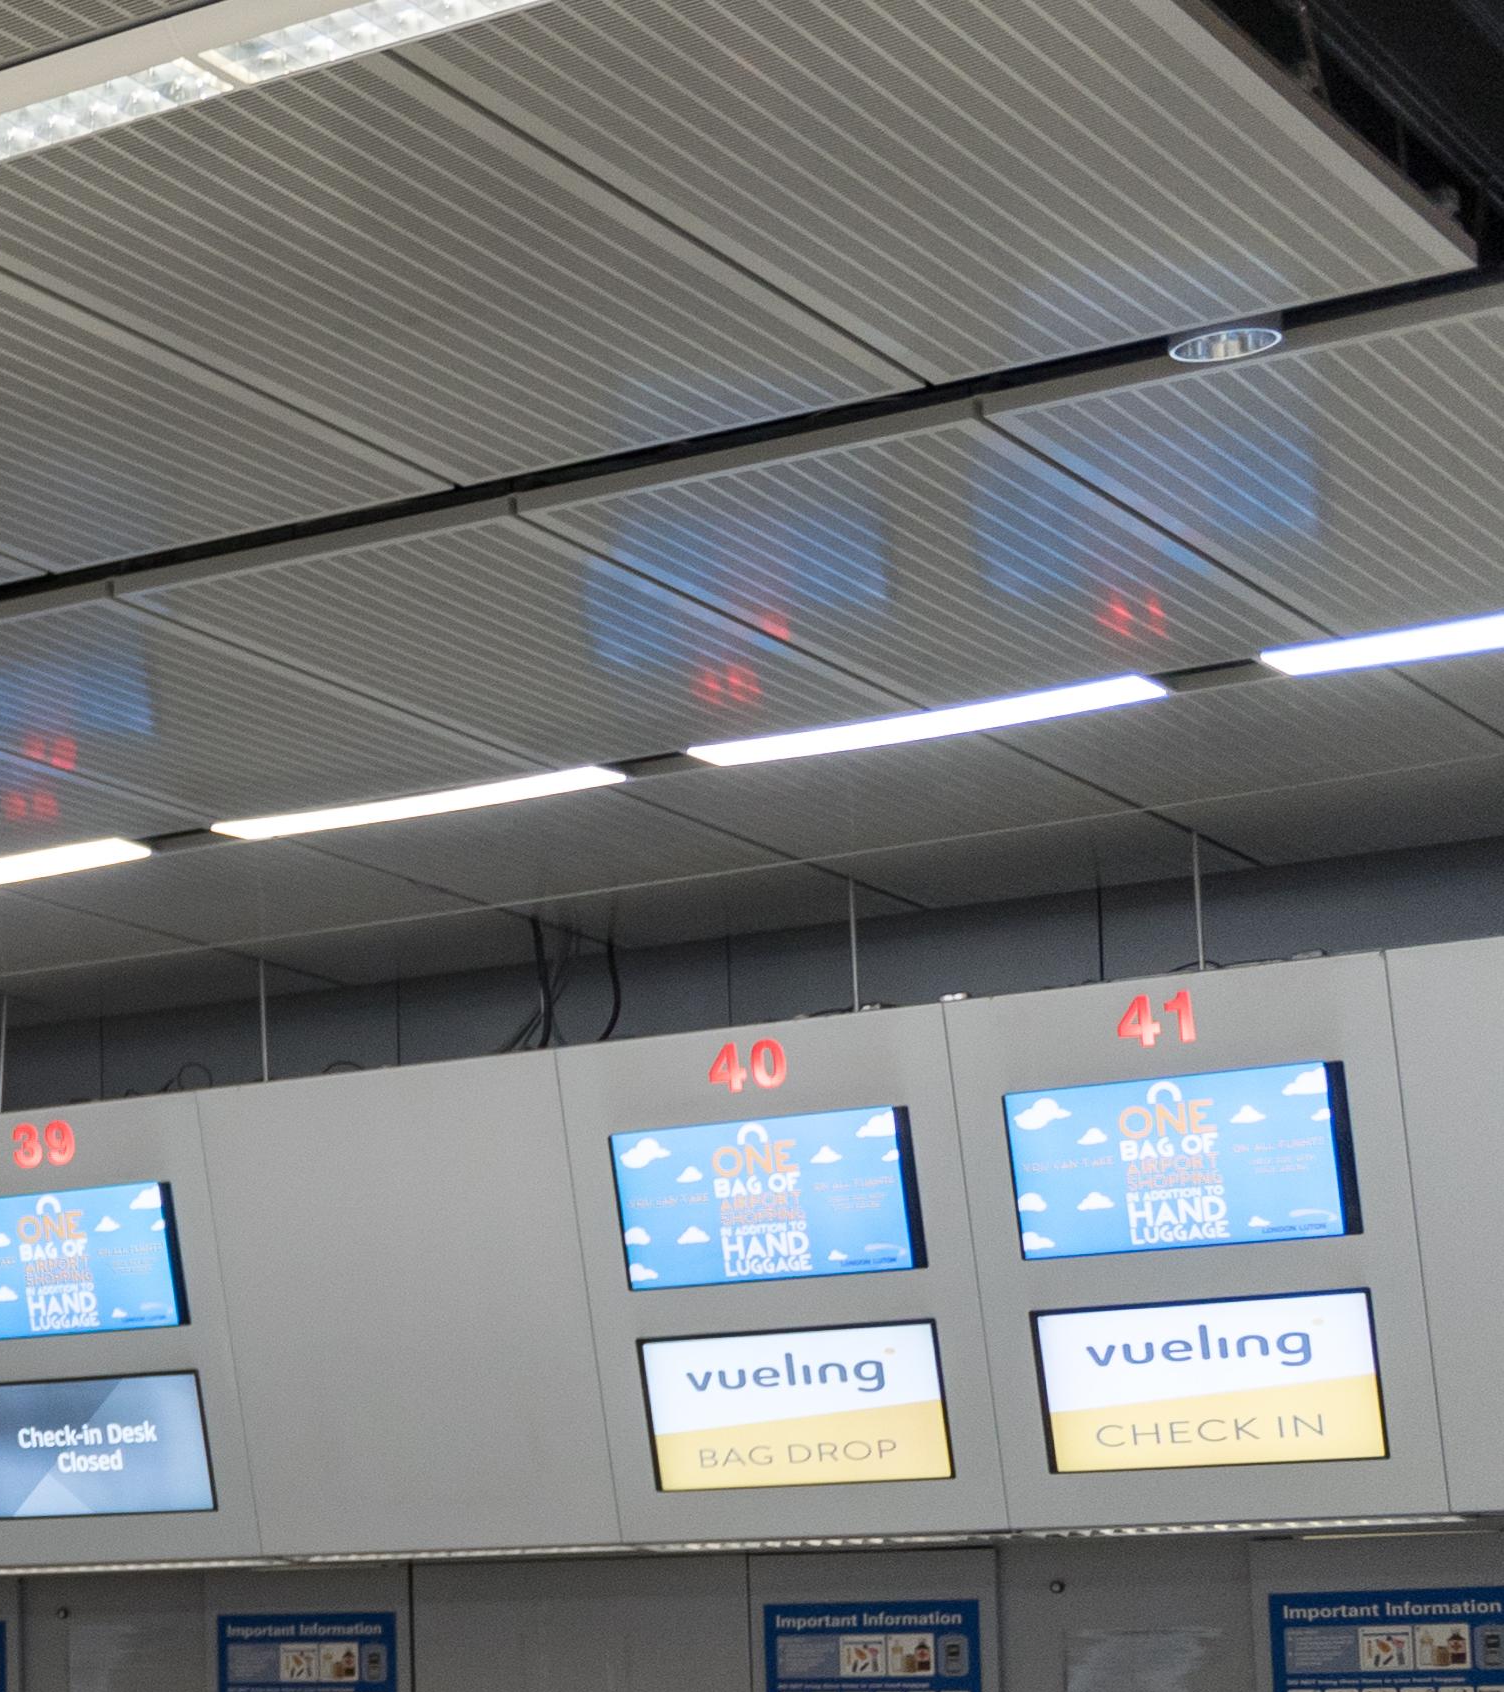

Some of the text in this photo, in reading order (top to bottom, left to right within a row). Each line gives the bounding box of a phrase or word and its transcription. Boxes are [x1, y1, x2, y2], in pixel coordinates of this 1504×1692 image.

[1118, 989, 1196, 1048] 41
[708, 1039, 787, 1094] 40
[1118, 1099, 1219, 1139] ONE
[12, 1119, 75, 1169] 39
[1120, 1132, 1218, 1162] BAG OF
[712, 1139, 799, 1178] ONE
[1127, 1152, 1218, 1175] AIRPORT
[713, 1172, 801, 1199] BAG OF
[1126, 1185, 1225, 1202] IN ADDITION TO
[1127, 1173, 1223, 1191] SHOPPING
[1127, 1195, 1227, 1229] HAND
[17, 1211, 86, 1244] ONE
[720, 1220, 807, 1237] IN ADDITION TO
[1131, 1220, 1231, 1245] LUGGAGE
[18, 1242, 58, 1262] BAG
[61, 1237, 88, 1257] OF
[721, 1231, 810, 1261] HAND
[724, 1254, 813, 1278] LUGGAGE
[81, 1281, 94, 1291] TO
[27, 1292, 97, 1318] HAND
[30, 1312, 101, 1332] LUGGAGE
[1086, 1324, 1314, 1367] vueling
[686, 1352, 886, 1393] vueling
[18, 1420, 157, 1449] Check-in Desk
[1095, 1413, 1325, 1449] CHECK IN
[57, 1449, 123, 1473] Closed
[698, 1438, 897, 1469] BAG DROP
[776, 1611, 962, 1630] Important Information
[1283, 1599, 1501, 1621] Important Information
[226, 1621, 382, 1639] Important Information
